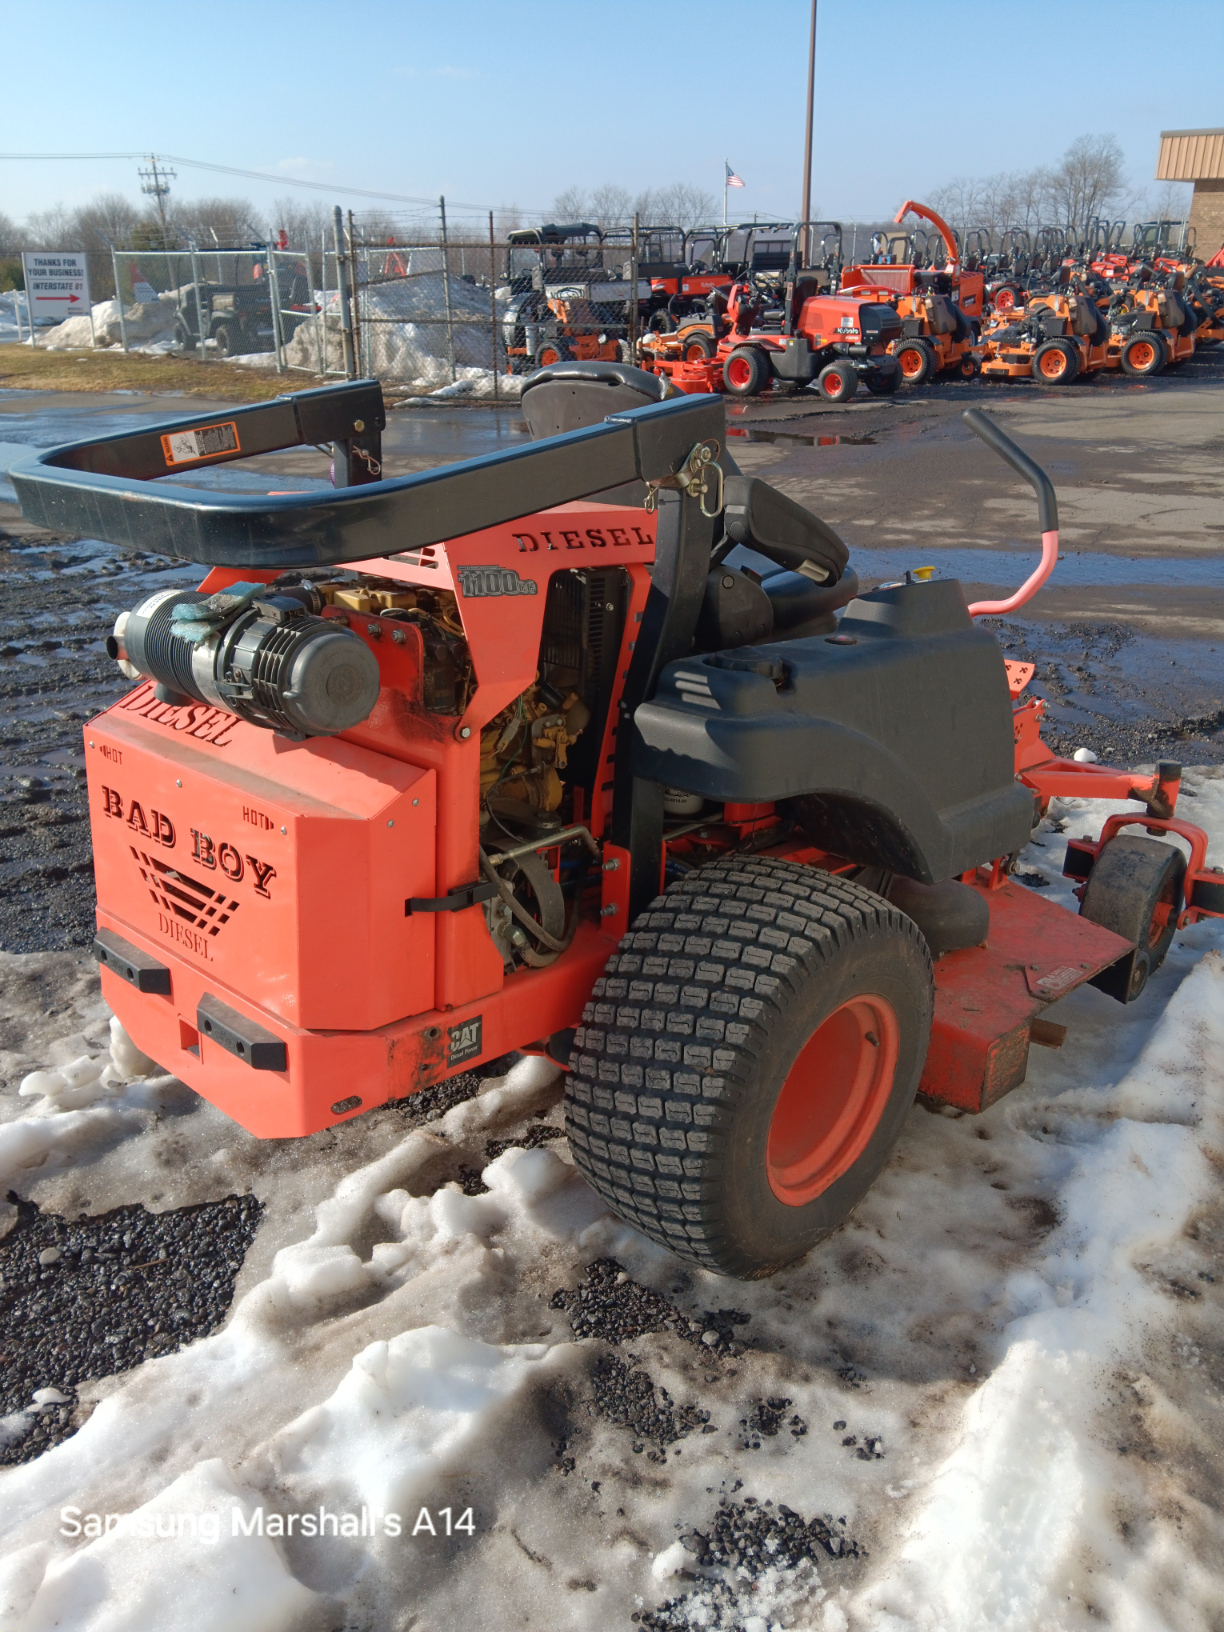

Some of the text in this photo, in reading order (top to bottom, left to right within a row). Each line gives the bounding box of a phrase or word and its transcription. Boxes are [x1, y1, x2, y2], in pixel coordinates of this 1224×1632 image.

[28, 268, 47, 276] YOUR
[34, 259, 76, 267] THANKS FOR
[33, 282, 73, 290] INTERSTATE
[837, 327, 859, 335] Kubota
[512, 526, 655, 553] DIESEL
[119, 685, 245, 748] DIESEL
[106, 746, 123, 766] HOT
[242, 806, 264, 830] HOT
[101, 785, 278, 900] BAD BOY
[158, 912, 215, 962] DIESEL
[451, 1022, 478, 1051] CAT
